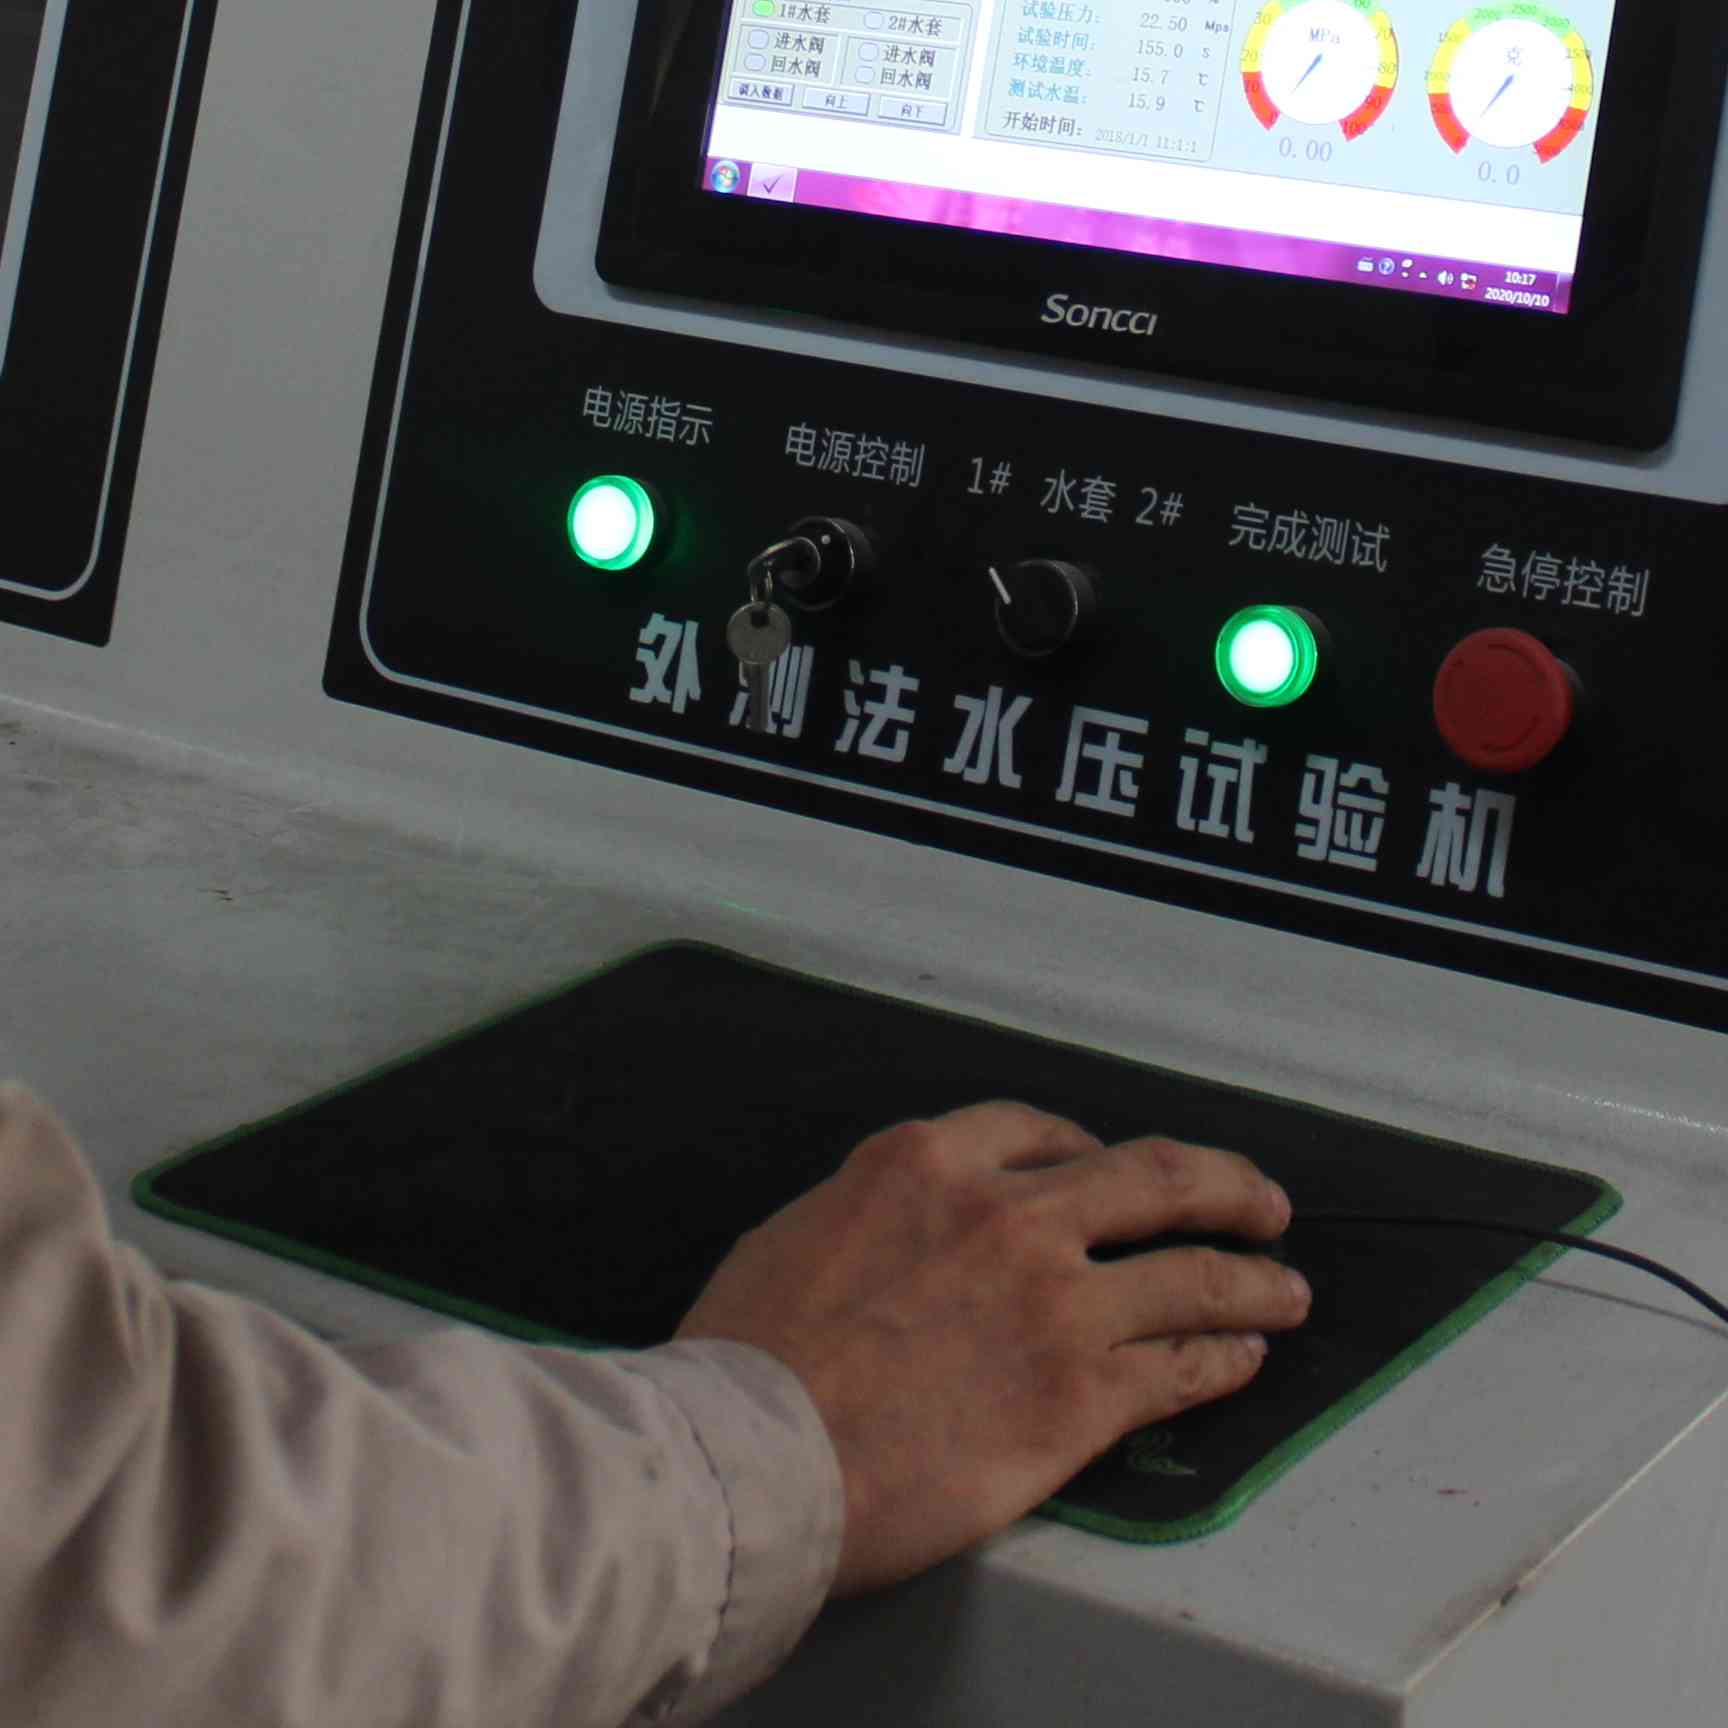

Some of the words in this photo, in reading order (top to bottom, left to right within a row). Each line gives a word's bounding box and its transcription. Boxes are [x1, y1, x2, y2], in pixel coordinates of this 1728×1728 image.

[1139, 12, 1189, 32] 22.50
[1136, 38, 1184, 59] 155.0
[1131, 66, 1170, 85] 15.7
[1128, 92, 1166, 112] 15.9
[1277, 136, 1333, 163] 0.00
[1476, 159, 1521, 186] 0.0
[1504, 270, 1537, 286] 10:17
[1484, 286, 1551, 308] 2020/10/10
[582, 384, 714, 447] 电源指示
[784, 422, 927, 489] 电源控制
[967, 456, 1013, 496] 1#
[1039, 468, 1118, 524] 水套
[1135, 486, 1185, 527] 2#
[1228, 500, 1391, 575] 完成测试
[1475, 541, 1652, 620] 急停控制
[628, 611, 1517, 899] 外测法水压试验机
